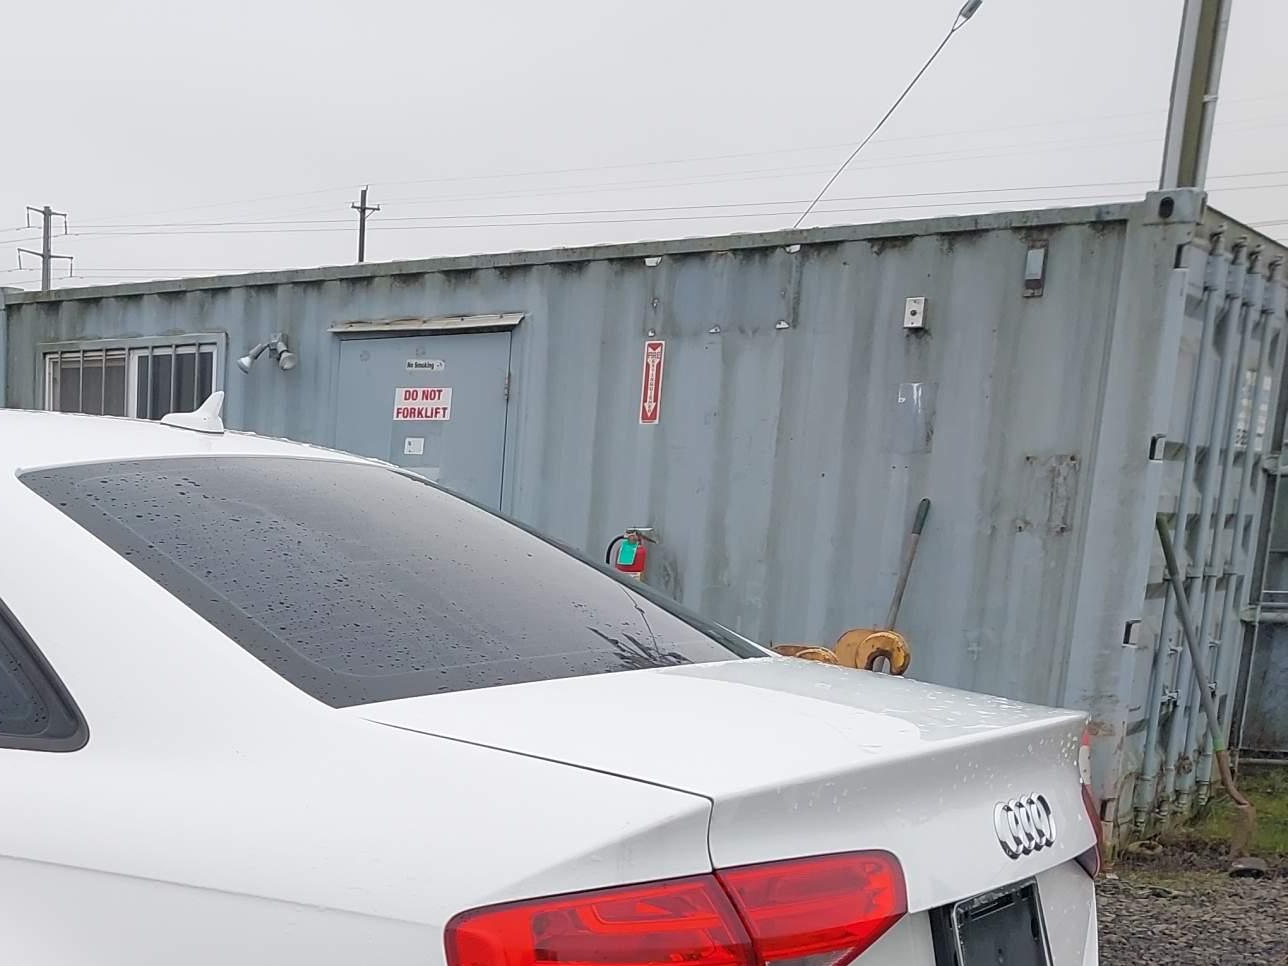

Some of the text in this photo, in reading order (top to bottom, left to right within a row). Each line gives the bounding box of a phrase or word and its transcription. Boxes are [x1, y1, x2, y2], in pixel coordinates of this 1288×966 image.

[404, 390, 442, 400] DO NOT
[396, 407, 448, 418] FORKLIFT
